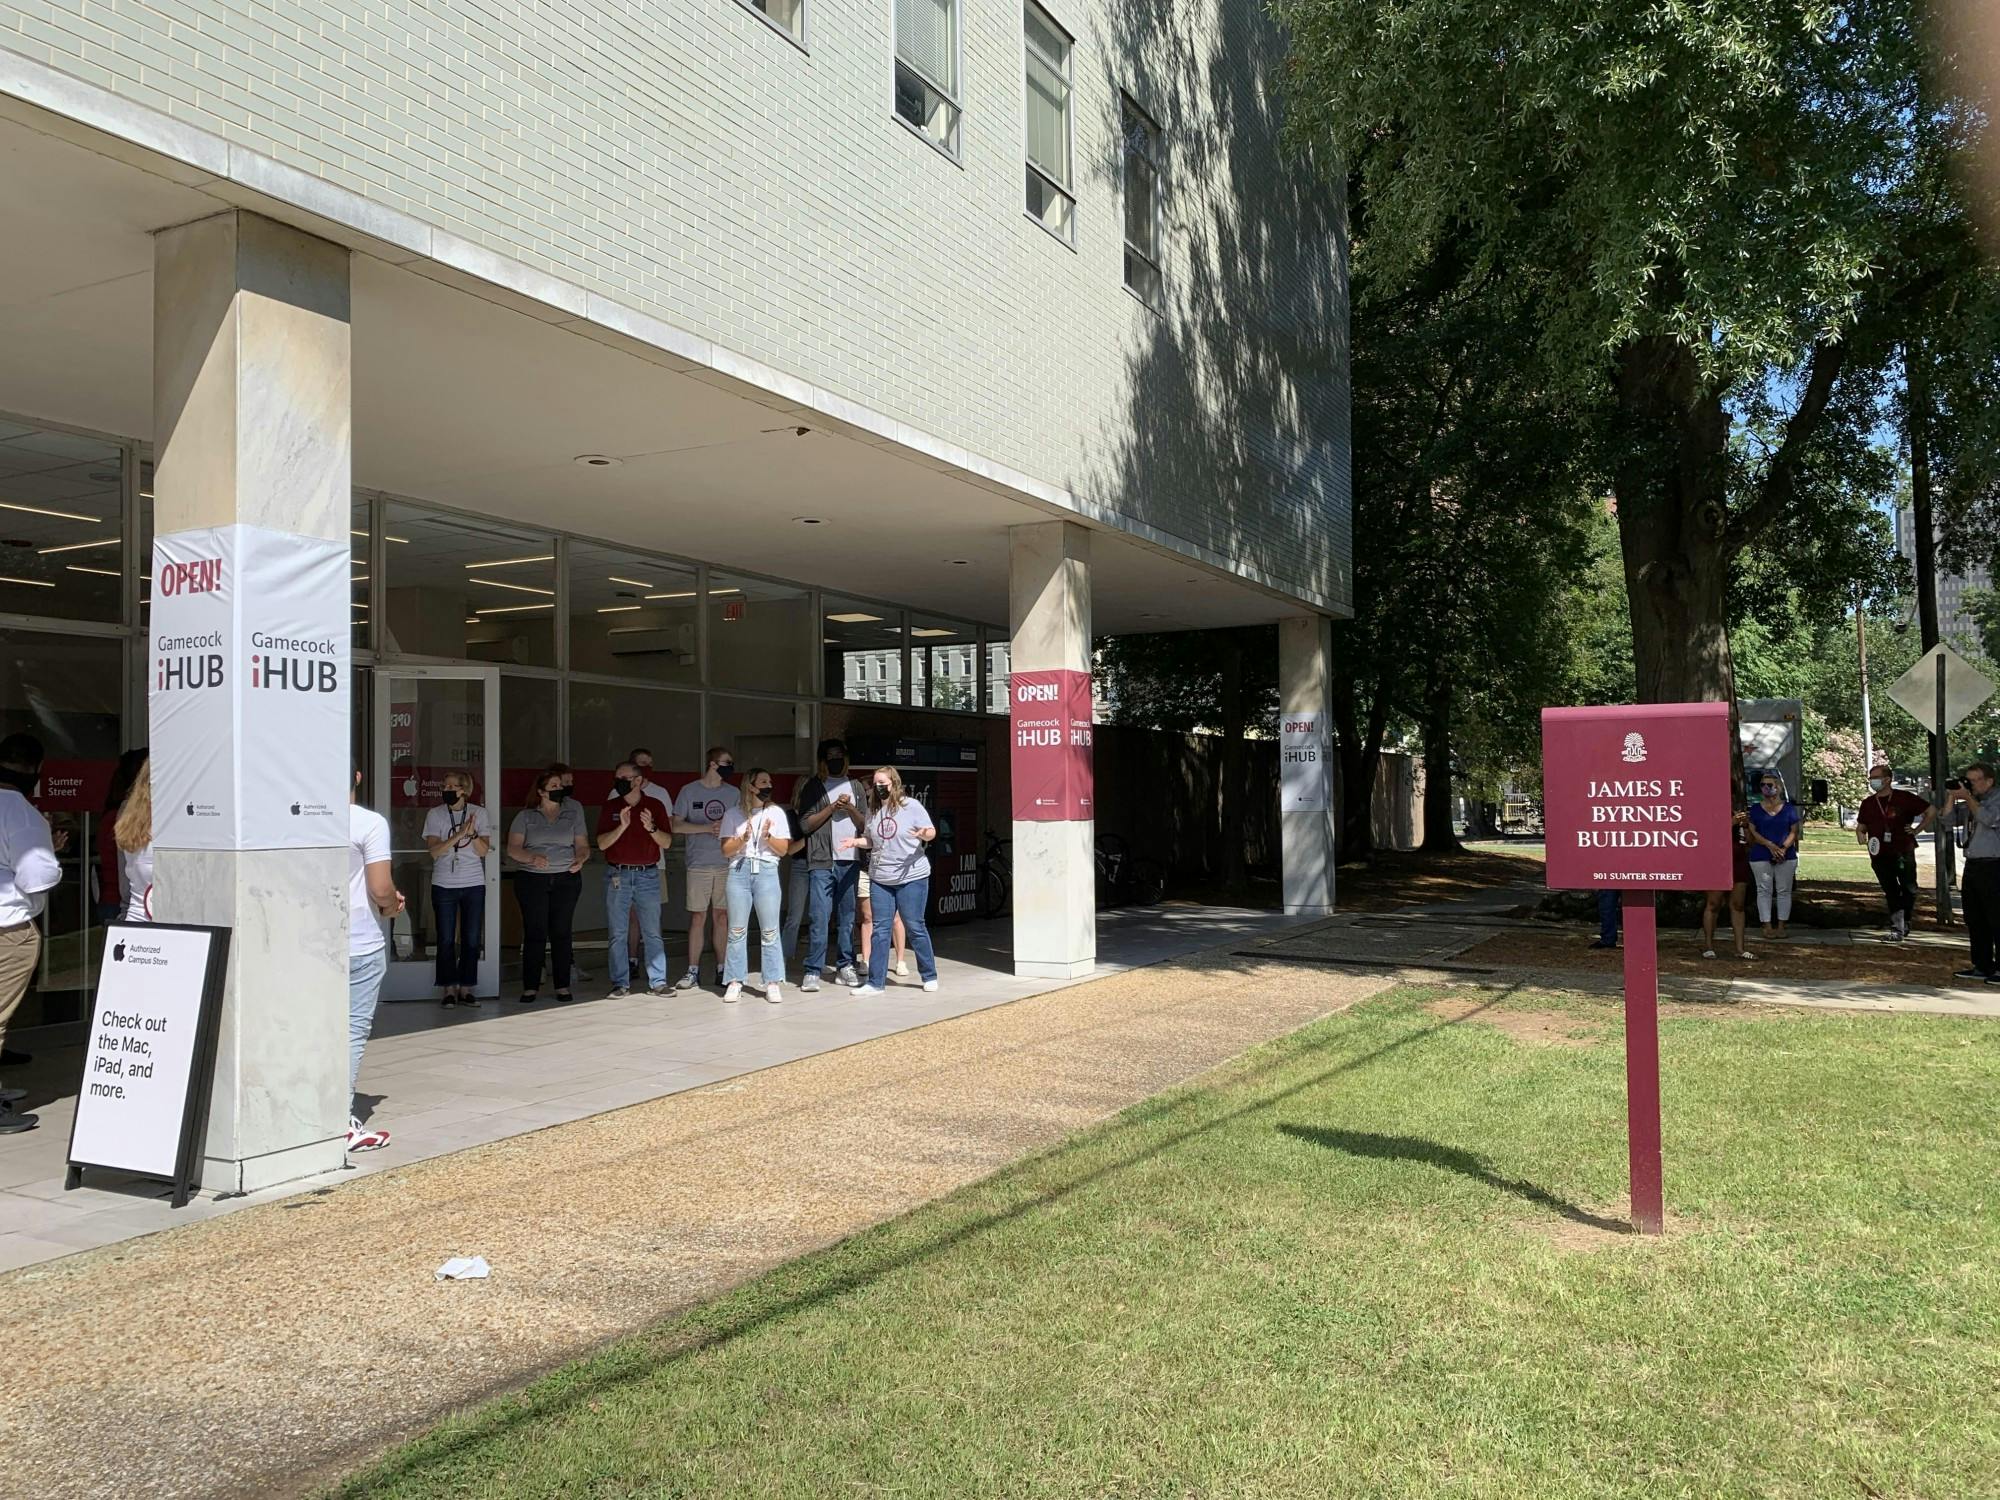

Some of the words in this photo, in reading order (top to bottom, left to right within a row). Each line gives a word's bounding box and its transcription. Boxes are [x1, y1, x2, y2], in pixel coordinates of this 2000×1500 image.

[160, 558, 222, 597] OPEN!
[158, 631, 222, 651] Gamecock
[252, 632, 336, 655] Gamecock
[158, 654, 224, 691] iHUB
[252, 654, 337, 693] iHUB
[1018, 684, 1058, 702] OPEN!
[1017, 718, 1060, 728] Gamecock
[1285, 721, 1314, 733] OPEN!
[1017, 729, 1061, 747] iHUB
[1070, 729, 1092, 746] iHUB
[1285, 751, 1316, 763] iHUB
[48, 777, 83, 786] Sumter
[1587, 780, 1662, 798] JAMES
[1669, 780, 1685, 797] F.
[48, 787, 76, 796] Street
[1591, 805, 1682, 823] BYRNES
[1577, 830, 1699, 848] BUILDING
[965, 855, 976, 871] AM
[950, 874, 976, 893] SOUTH
[938, 894, 976, 914] CAROLINA
[129, 944, 161, 954] Authorized
[128, 955, 151, 965] Campus
[152, 956, 168, 966] Store
[102, 1010, 142, 1030] Check
[145, 1017, 167, 1033] out
[98, 1033, 119, 1051] the
[121, 1036, 153, 1059] Mac,
[93, 1055, 124, 1079] iPad,
[128, 1062, 154, 1079] and
[90, 1082, 126, 1100] more.
